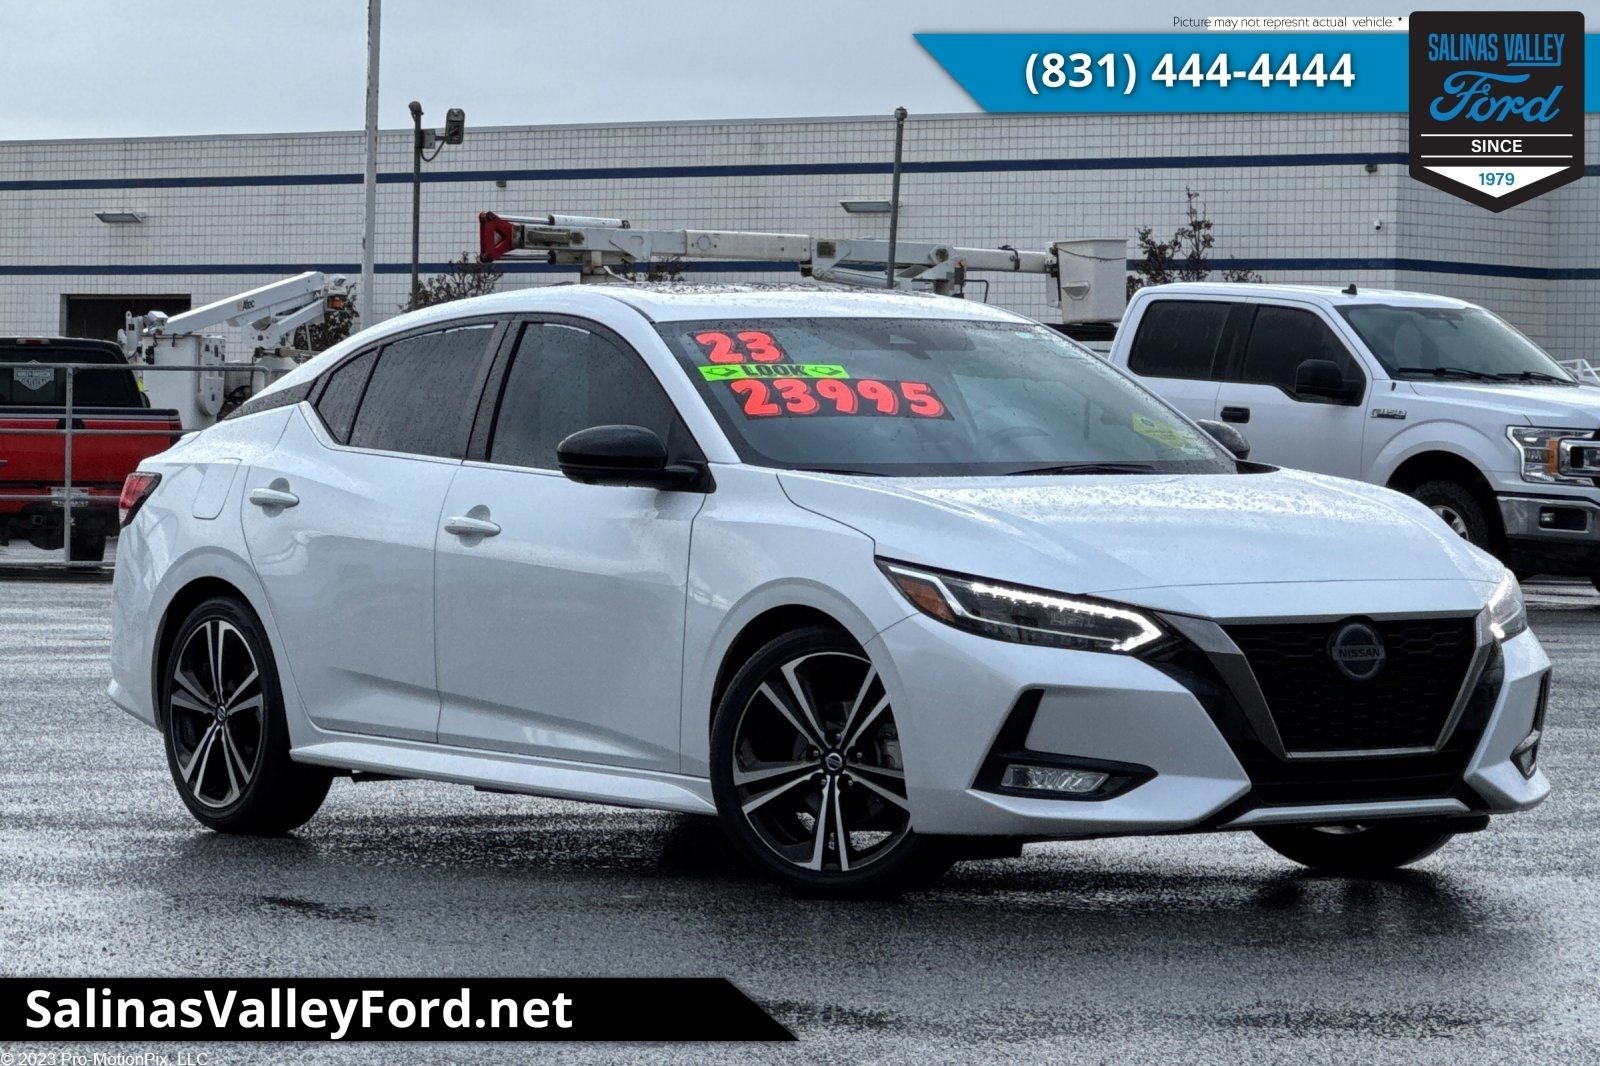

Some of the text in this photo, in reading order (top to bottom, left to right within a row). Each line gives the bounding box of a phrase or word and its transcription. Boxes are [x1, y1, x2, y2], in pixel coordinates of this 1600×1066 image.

[695, 331, 785, 363] 23
[740, 364, 809, 378] LOOK
[730, 379, 944, 417] 23995
[1338, 647, 1380, 657] NISSAN
